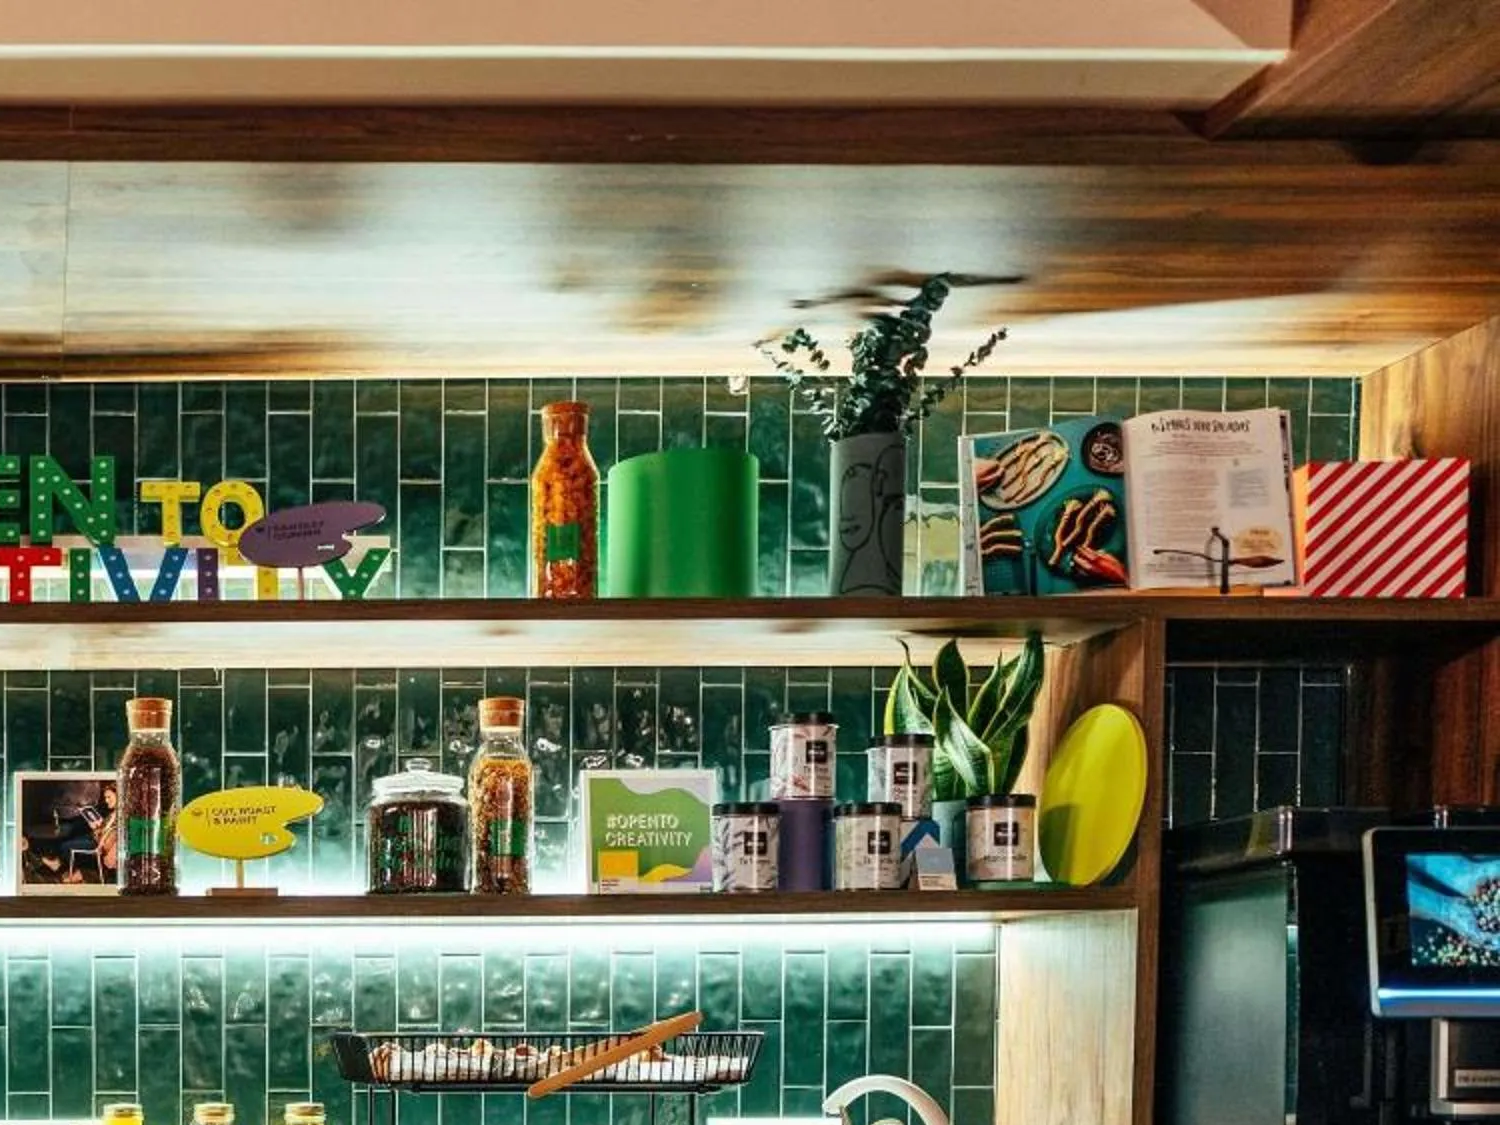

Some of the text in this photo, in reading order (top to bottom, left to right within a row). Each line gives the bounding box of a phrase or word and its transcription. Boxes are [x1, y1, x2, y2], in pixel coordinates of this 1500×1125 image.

[140, 480, 266, 547] TO
[606, 813, 680, 830] #OPENTO
[605, 830, 693, 848] CREATIVITY
